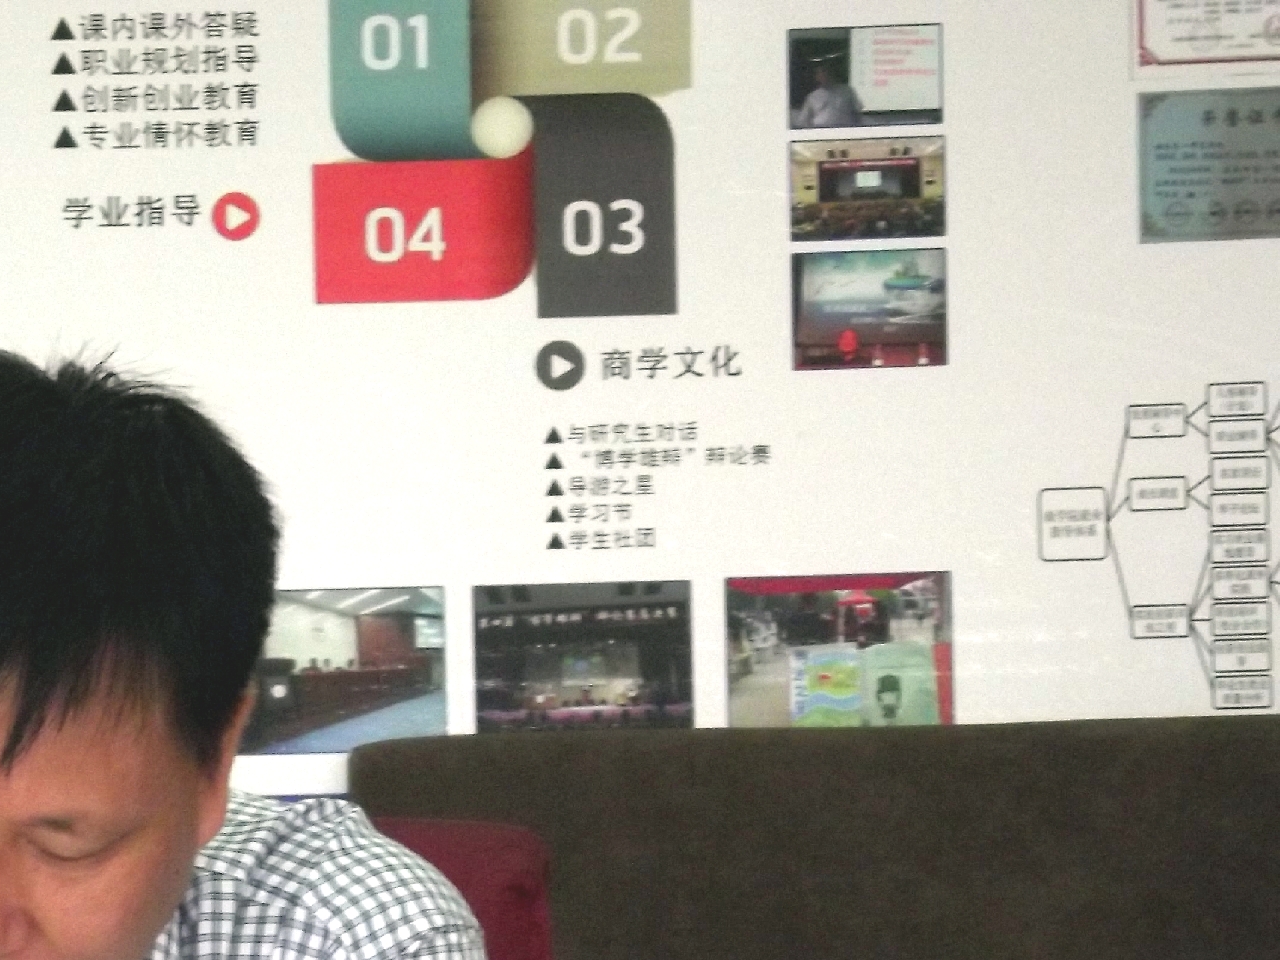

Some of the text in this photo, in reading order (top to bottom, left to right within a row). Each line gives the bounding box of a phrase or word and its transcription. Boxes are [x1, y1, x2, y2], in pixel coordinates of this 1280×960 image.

[78, 11, 260, 40] 课内课外答疑
[556, 8, 643, 65] 02
[360, 14, 429, 71] 01
[80, 45, 260, 75] 职业规划指导
[81, 82, 260, 113] 创新创业教育
[82, 120, 260, 149] 专业情怀教育
[62, 194, 202, 229] 学业指导
[364, 206, 447, 264] 04
[562, 198, 647, 257] 03
[601, 345, 743, 380] 商学文化
[568, 421, 699, 444] 与研究生对话
[569, 474, 655, 497] 导游之星
[568, 503, 633, 524] 学习节
[569, 527, 657, 551] 学生社团
